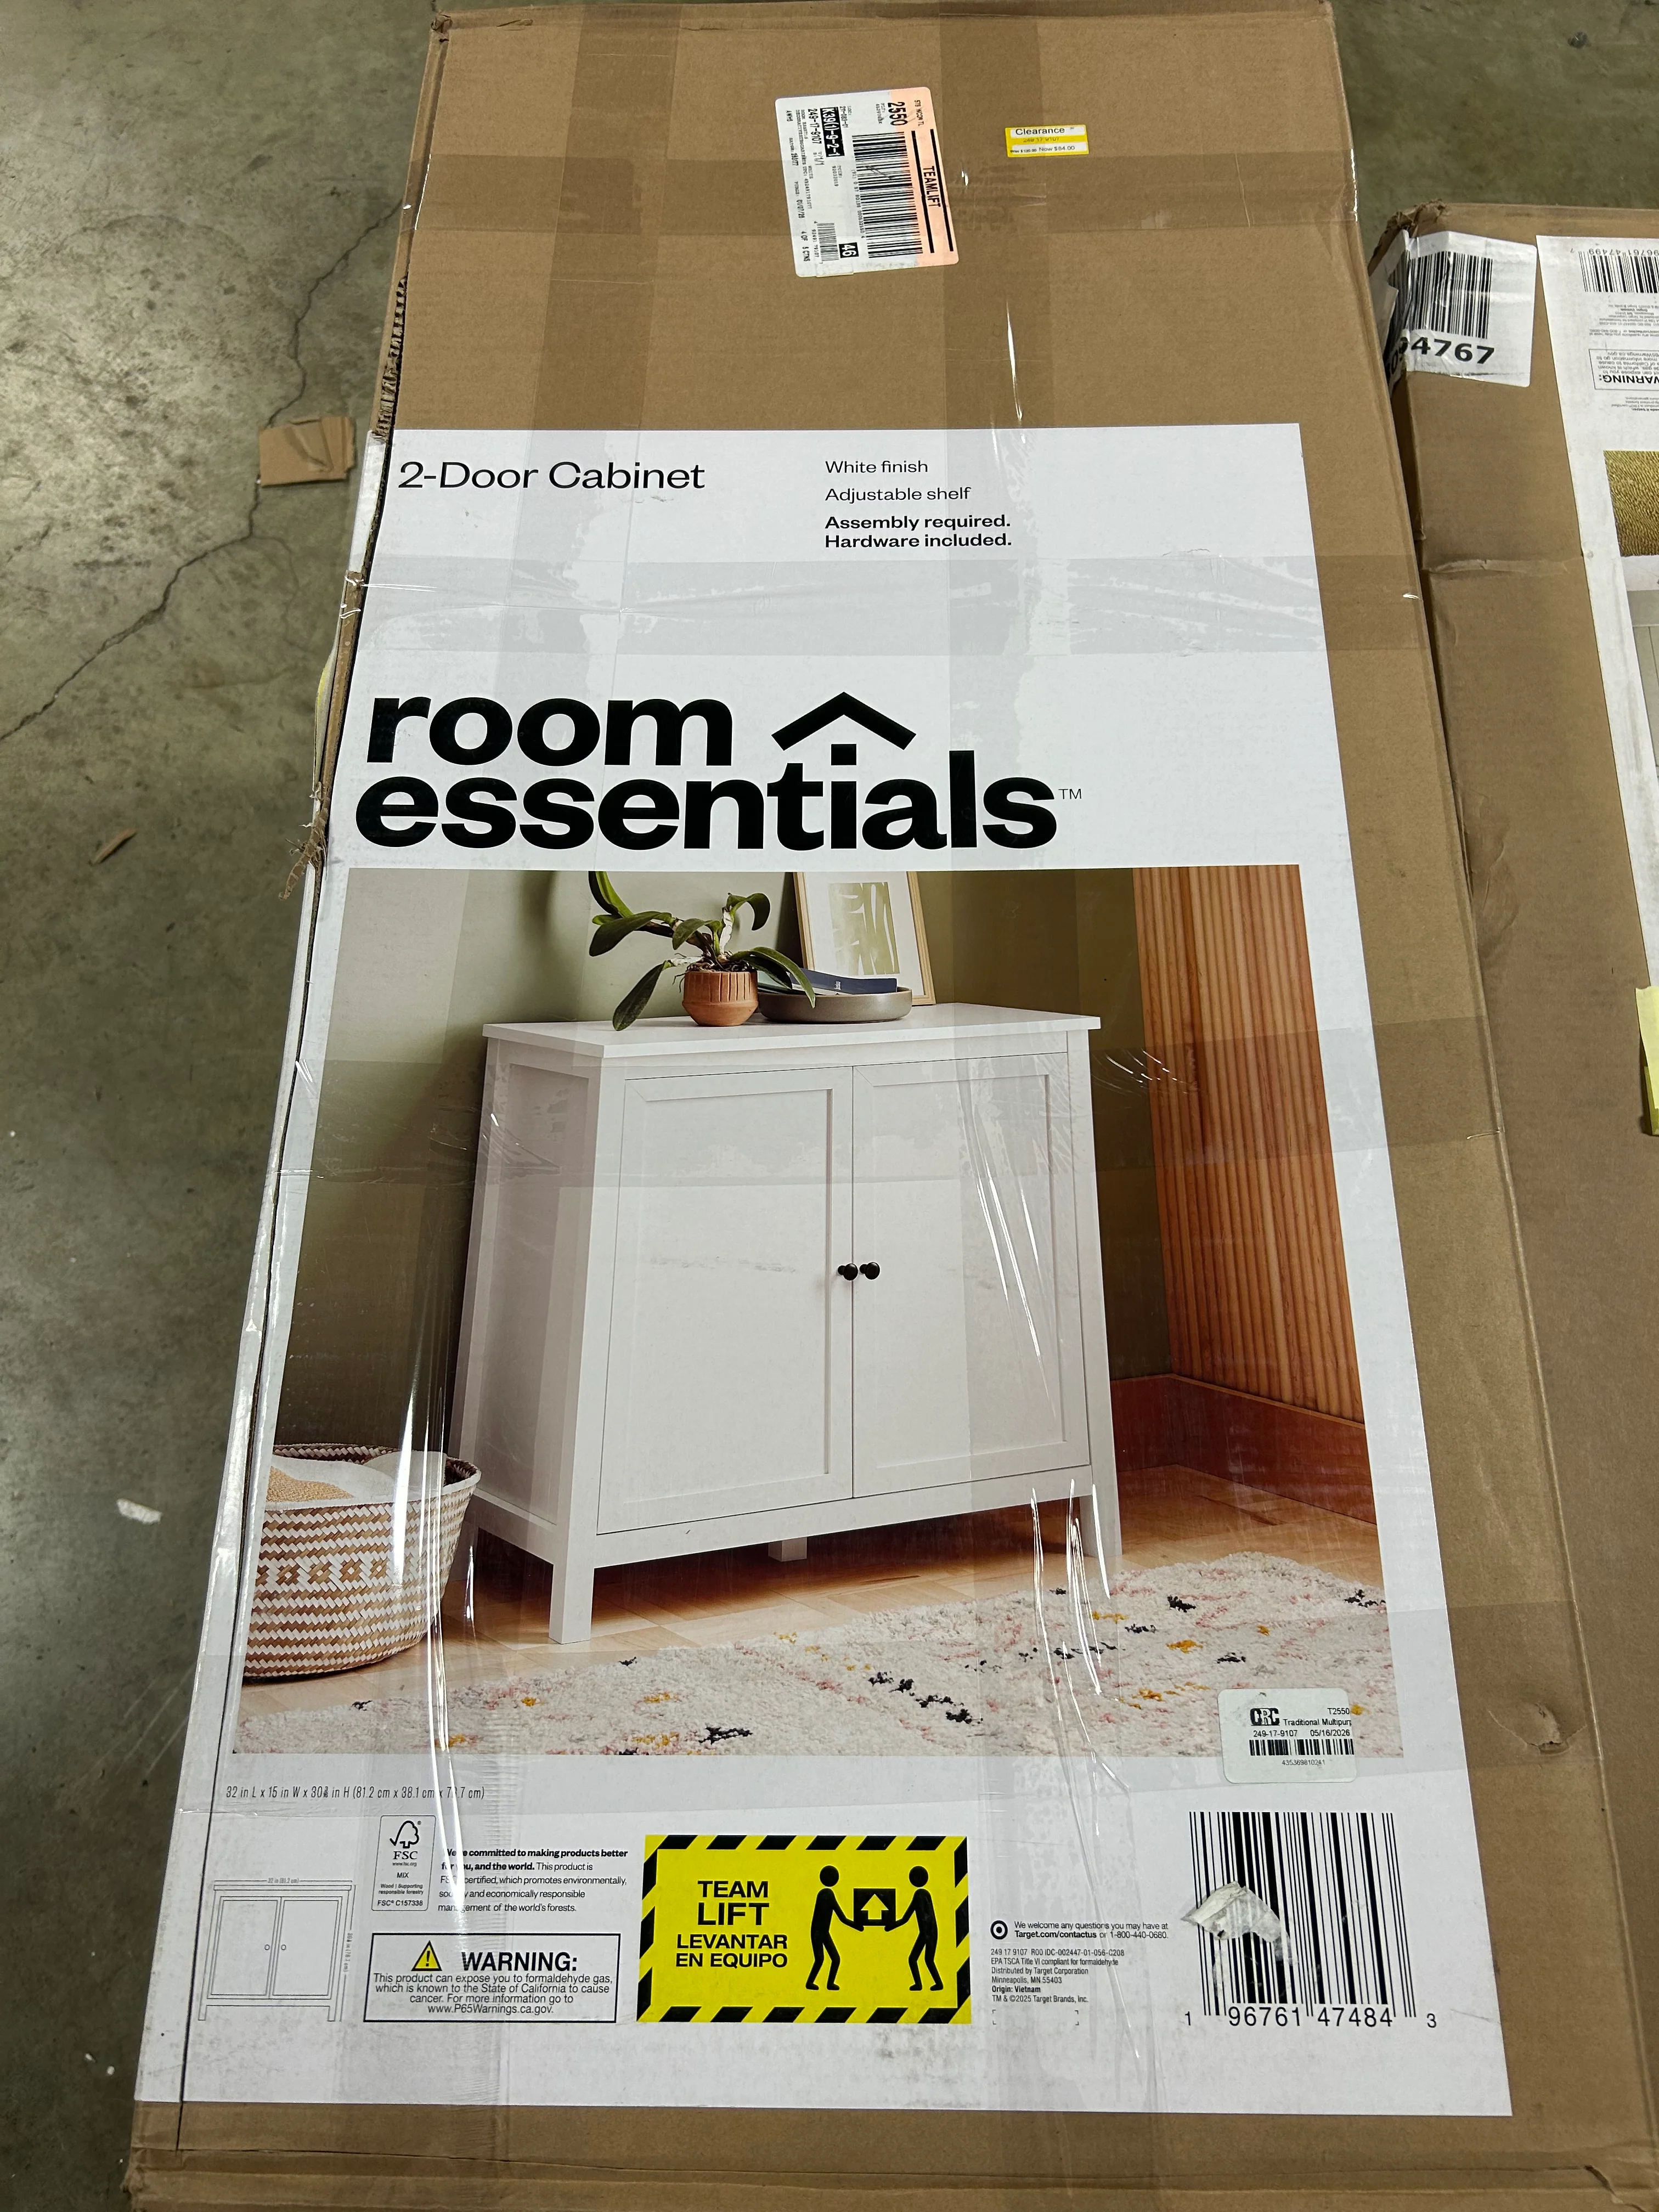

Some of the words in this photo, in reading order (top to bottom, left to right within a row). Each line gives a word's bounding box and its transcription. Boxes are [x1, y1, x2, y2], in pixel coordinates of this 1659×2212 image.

[888, 101, 908, 126] 2550
[808, 109, 822, 144] 249-17-9107
[822, 108, 841, 156] K39(1)-9-2-1
[1015, 127, 1065, 136] Clearance
[923, 166, 941, 207] TEAMLIFT
[842, 244, 857, 257] 46
[825, 460, 877, 475] White
[881, 460, 929, 475] finish
[398, 460, 539, 490] 2-Door
[548, 460, 706, 490] Cabinet
[825, 487, 922, 505] Adjustable
[926, 486, 972, 501] shelf
[825, 515, 919, 533] Assembly
[924, 515, 1011, 533] required.
[825, 534, 920, 549] Hardware
[924, 533, 1012, 548] included.
[367, 695, 732, 767] room
[356, 743, 1057, 851] essentials
[1250, 1708, 1280, 1726] CRC
[226, 1786, 238, 1798] 32
[240, 1786, 249, 1798] in
[268, 1786, 278, 1798] 15
[281, 1786, 289, 1798] in
[332, 1786, 340, 1798] in
[353, 1786, 375, 1799] (81.2
[377, 1789, 390, 1798] cm
[402, 1786, 419, 1798] 38.1
[422, 1789, 435, 1798] cm
[469, 1786, 485, 1799] cm)
[393, 1851, 418, 1860] FSC
[469, 1849, 516, 1857] committed
[527, 1849, 559, 1858] making
[561, 1849, 600, 1858] products
[475, 1862, 491, 1870] and
[493, 1862, 506, 1870] the
[508, 1862, 535, 1870] world.
[536, 1862, 553, 1870] This
[554, 1862, 586, 1872] product
[499, 1876, 522, 1884] which
[523, 1876, 562, 1885] promotes
[563, 1876, 627, 1886] environmentally,
[470, 1889, 484, 1898] and
[486, 1889, 538, 1899] economically
[539, 1889, 585, 1899] responsible
[697, 1880, 768, 1898] TEAM
[494, 1903, 503, 1911] of
[504, 1903, 517, 1911] the
[547, 1903, 577, 1911] forests.
[697, 1903, 769, 1926] LIFT
[1075, 1922, 1109, 1931] questions
[676, 1934, 788, 1949] LEVANTAR
[1014, 1931, 1097, 1939] Target.com/contactus
[461, 1952, 578, 1971] WARNING:
[675, 1953, 703, 1967] EN
[710, 1953, 788, 1969] EQUIPO
[1041, 1957, 1070, 1967] compliant
[1079, 1957, 1119, 1967] formaldehyde
[1025, 1967, 1032, 1976] by
[1033, 1967, 1053, 1976] Target
[1054, 1967, 1088, 1976] Corporation
[374, 1973, 393, 1983] This
[396, 1973, 433, 1985] product
[436, 1975, 453, 1983] can
[455, 1975, 490, 1985] expose
[493, 1975, 510, 1985] you
[513, 1974, 522, 1983] to
[525, 1973, 590, 1985] formaldehyde
[592, 1975, 613, 1985] gas,
[991, 1976, 1029, 1985] Minneapolis,
[375, 1983, 403, 1993] which
[406, 1983, 414, 1993] is
[417, 1983, 448, 1993] known
[451, 1984, 460, 1993] to
[463, 1984, 478, 1993] the
[481, 1984, 505, 1993] State
[509, 1984, 519, 1993] of
[521, 1984, 566, 1994] California
[568, 1984, 578, 1993] to
[581, 1985, 610, 1993] cause
[992, 1985, 1013, 1994] Origin:
[410, 1995, 443, 2004] cancer.
[447, 1994, 462, 2004] For
[493, 1994, 546, 2004] information
[549, 1995, 561, 2005] go
[564, 1995, 573, 2004] to
[1034, 1995, 1052, 2004] Target
[1053, 1995, 1076, 2004] Brands,
[428, 2005, 554, 2015] www.P65Warnings.ca.gov.
[1184, 2011, 1192, 2026] 1
[1228, 2006, 1300, 2027] 96761
[1317, 2007, 1393, 2027] 47484
[1426, 2013, 1437, 2028] 3
